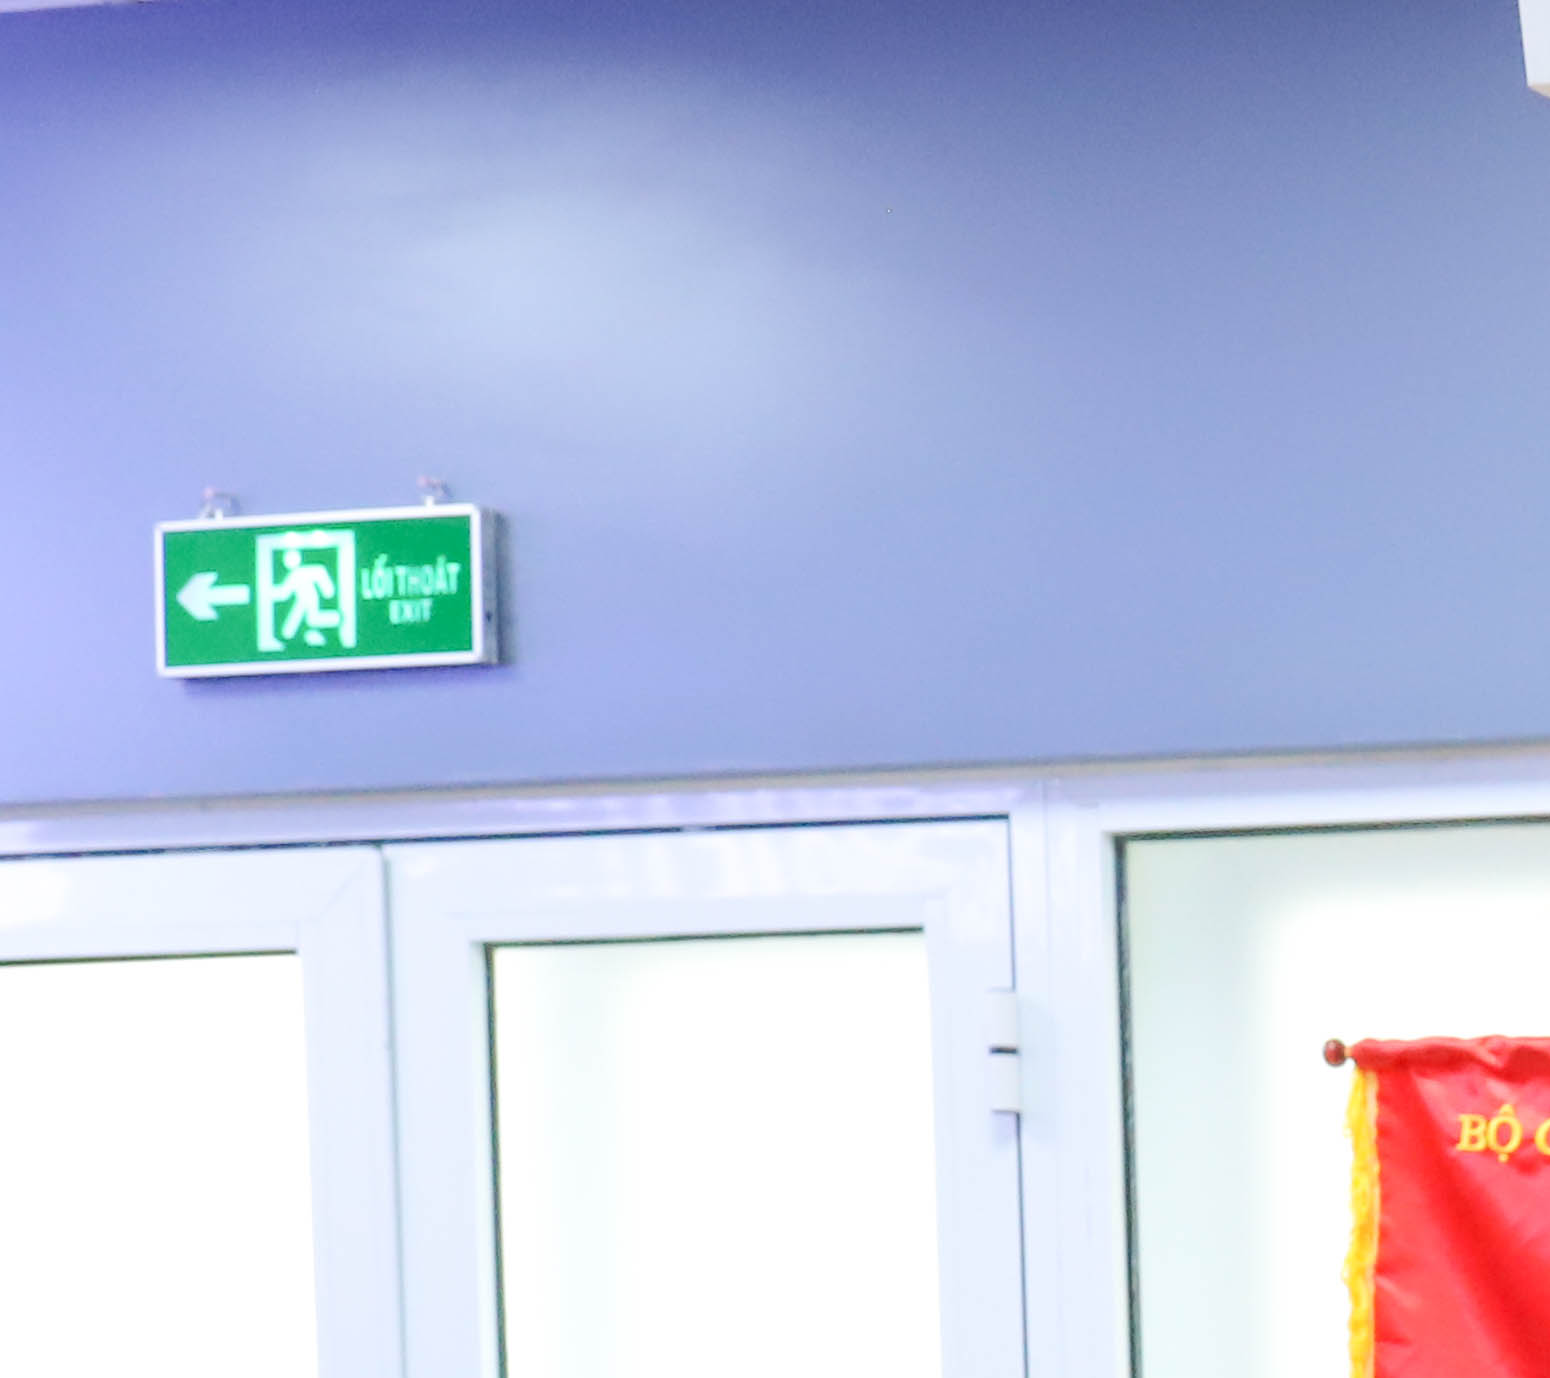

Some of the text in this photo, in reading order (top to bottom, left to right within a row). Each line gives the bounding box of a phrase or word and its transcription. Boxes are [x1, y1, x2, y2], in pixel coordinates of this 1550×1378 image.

[398, 554, 460, 597] THOÁT
[389, 598, 432, 625] EXIT
[1456, 1103, 1523, 1163] BỘ
